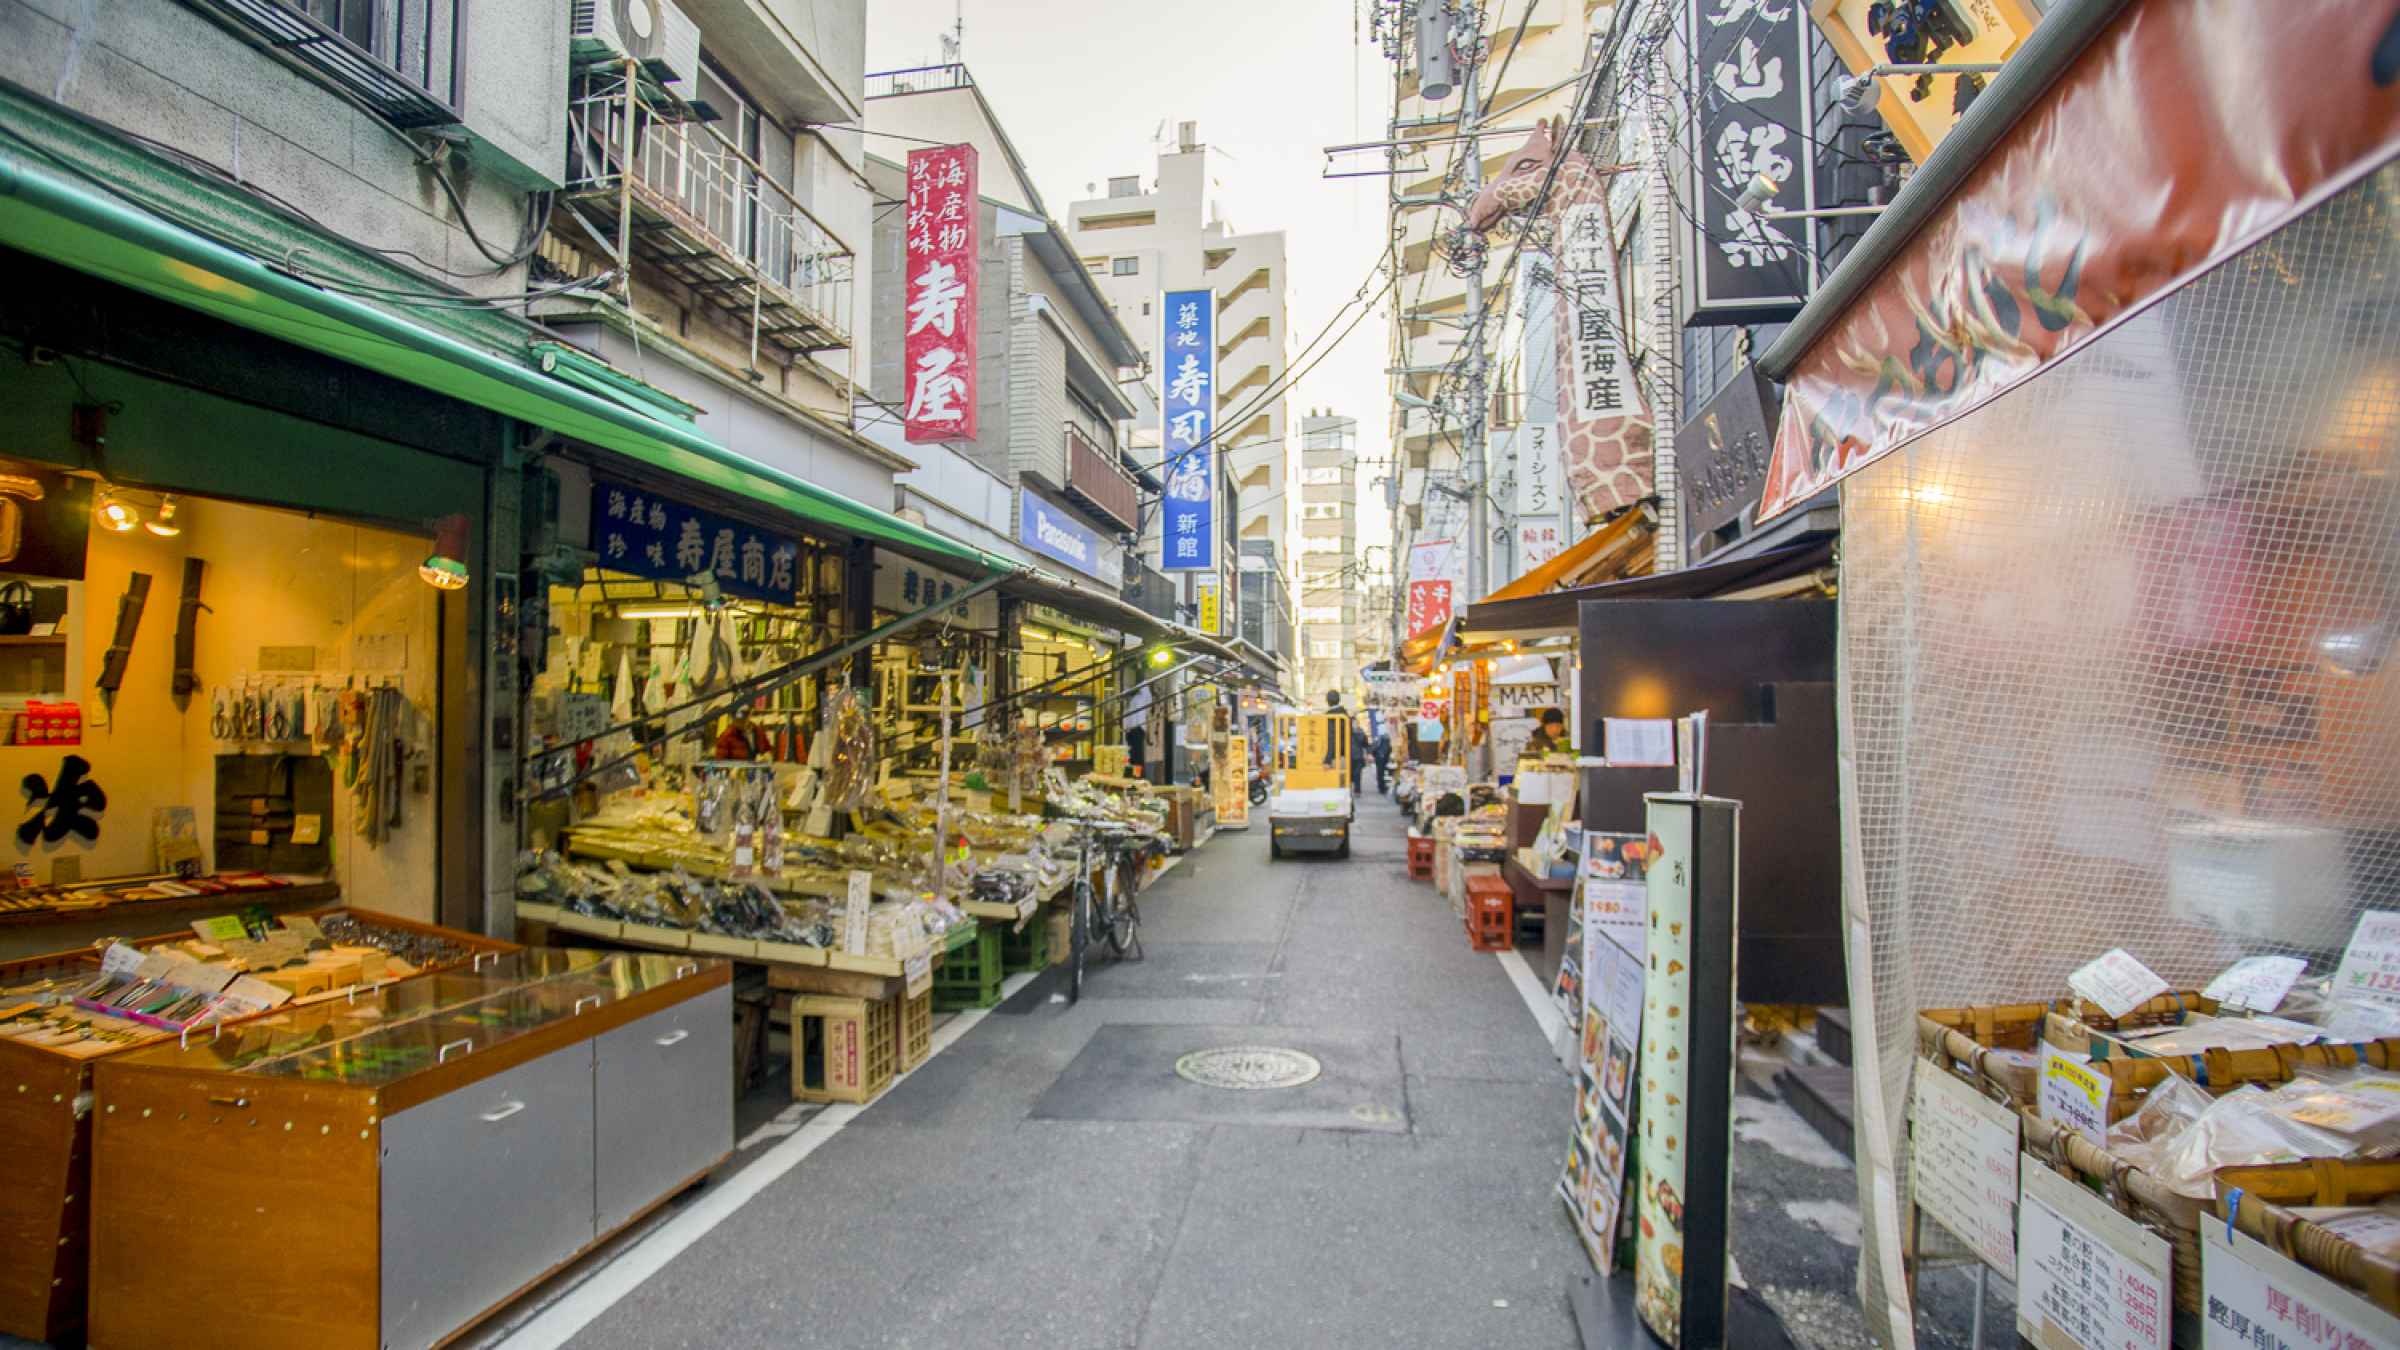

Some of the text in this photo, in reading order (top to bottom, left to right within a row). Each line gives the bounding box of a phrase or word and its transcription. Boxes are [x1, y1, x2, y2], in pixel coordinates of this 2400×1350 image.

[908, 157, 935, 255] 出汁珍味
[937, 159, 966, 250] 海産物
[906, 259, 966, 423] 寿屋
[1168, 303, 1210, 558] 築地 寿司清 新館
[608, 489, 667, 531] 海産物
[1036, 509, 1087, 562] Panasonic
[676, 516, 793, 591] 寿屋商店
[1500, 685, 1560, 705] MART
